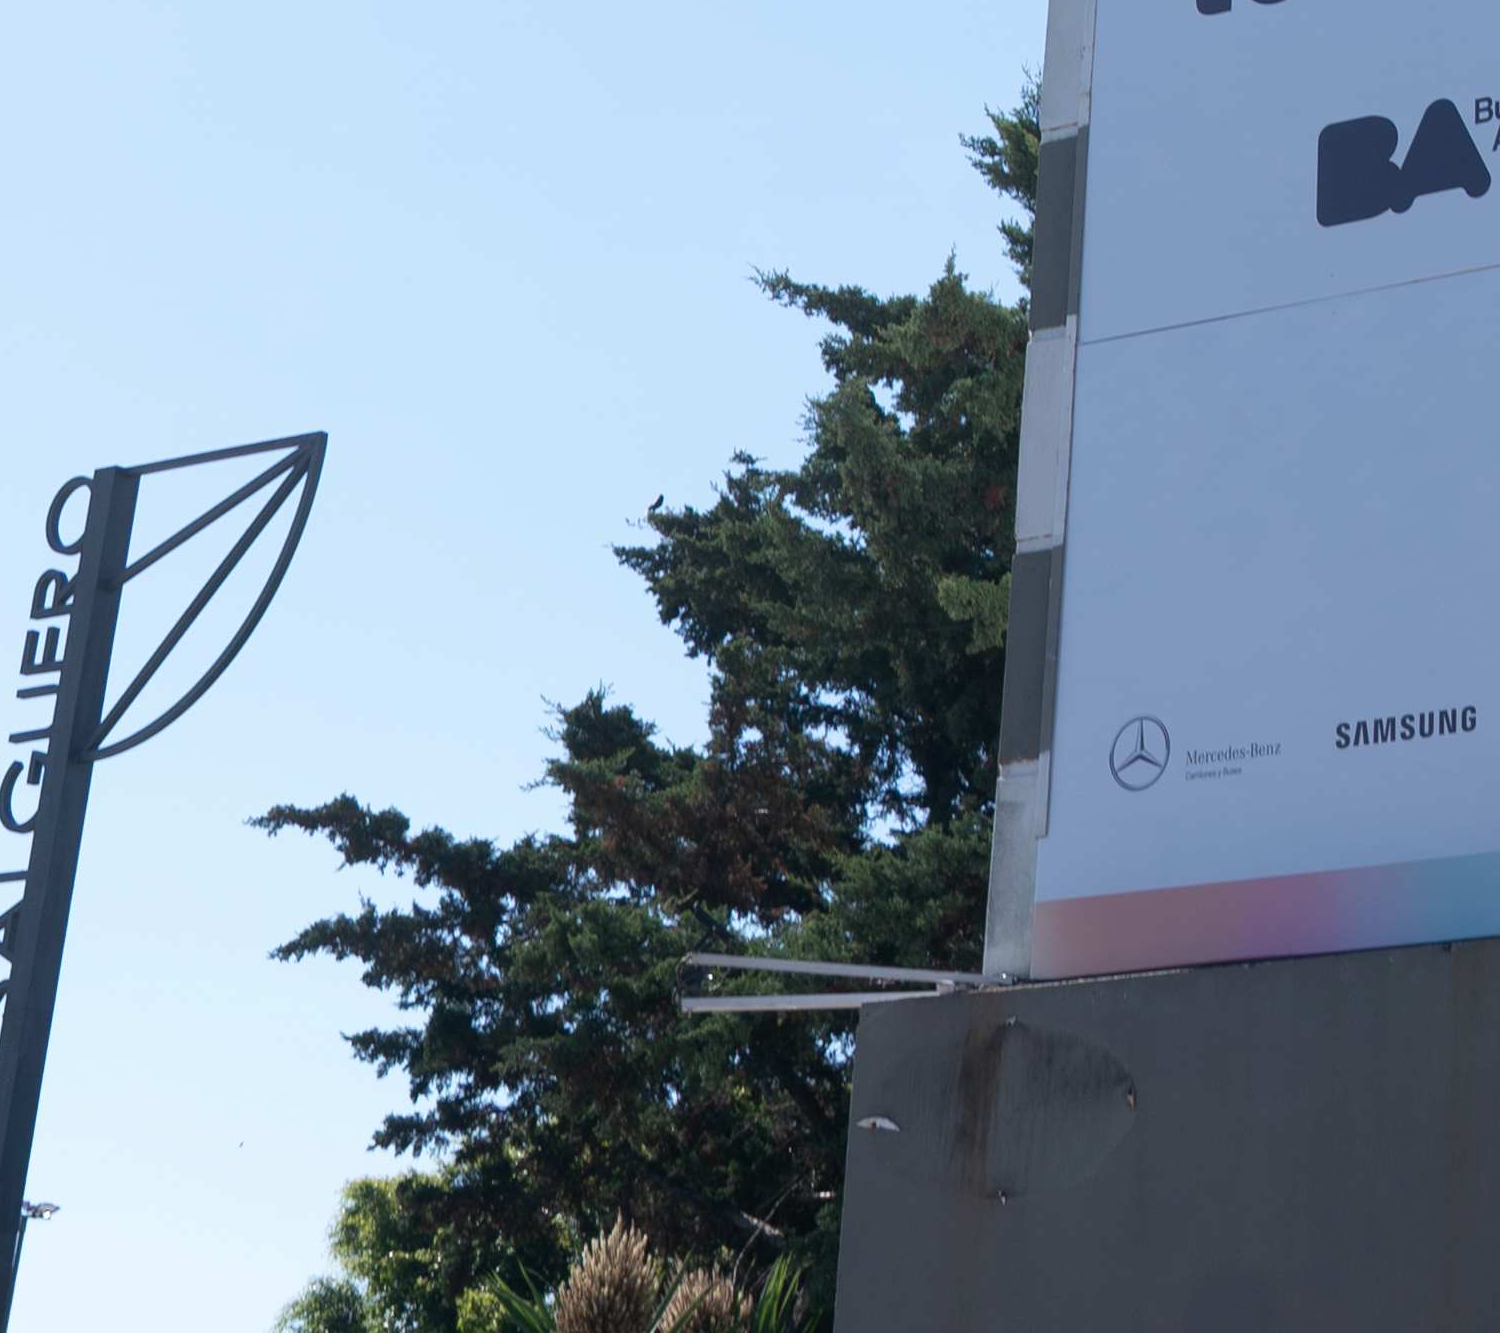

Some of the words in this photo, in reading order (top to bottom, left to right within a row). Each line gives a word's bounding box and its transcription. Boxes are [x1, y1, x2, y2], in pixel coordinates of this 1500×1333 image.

[1316, 98, 1491, 227] BA
[1336, 705, 1477, 749] SAMSUNG
[1186, 742, 1282, 766] Mercedes-Benz
